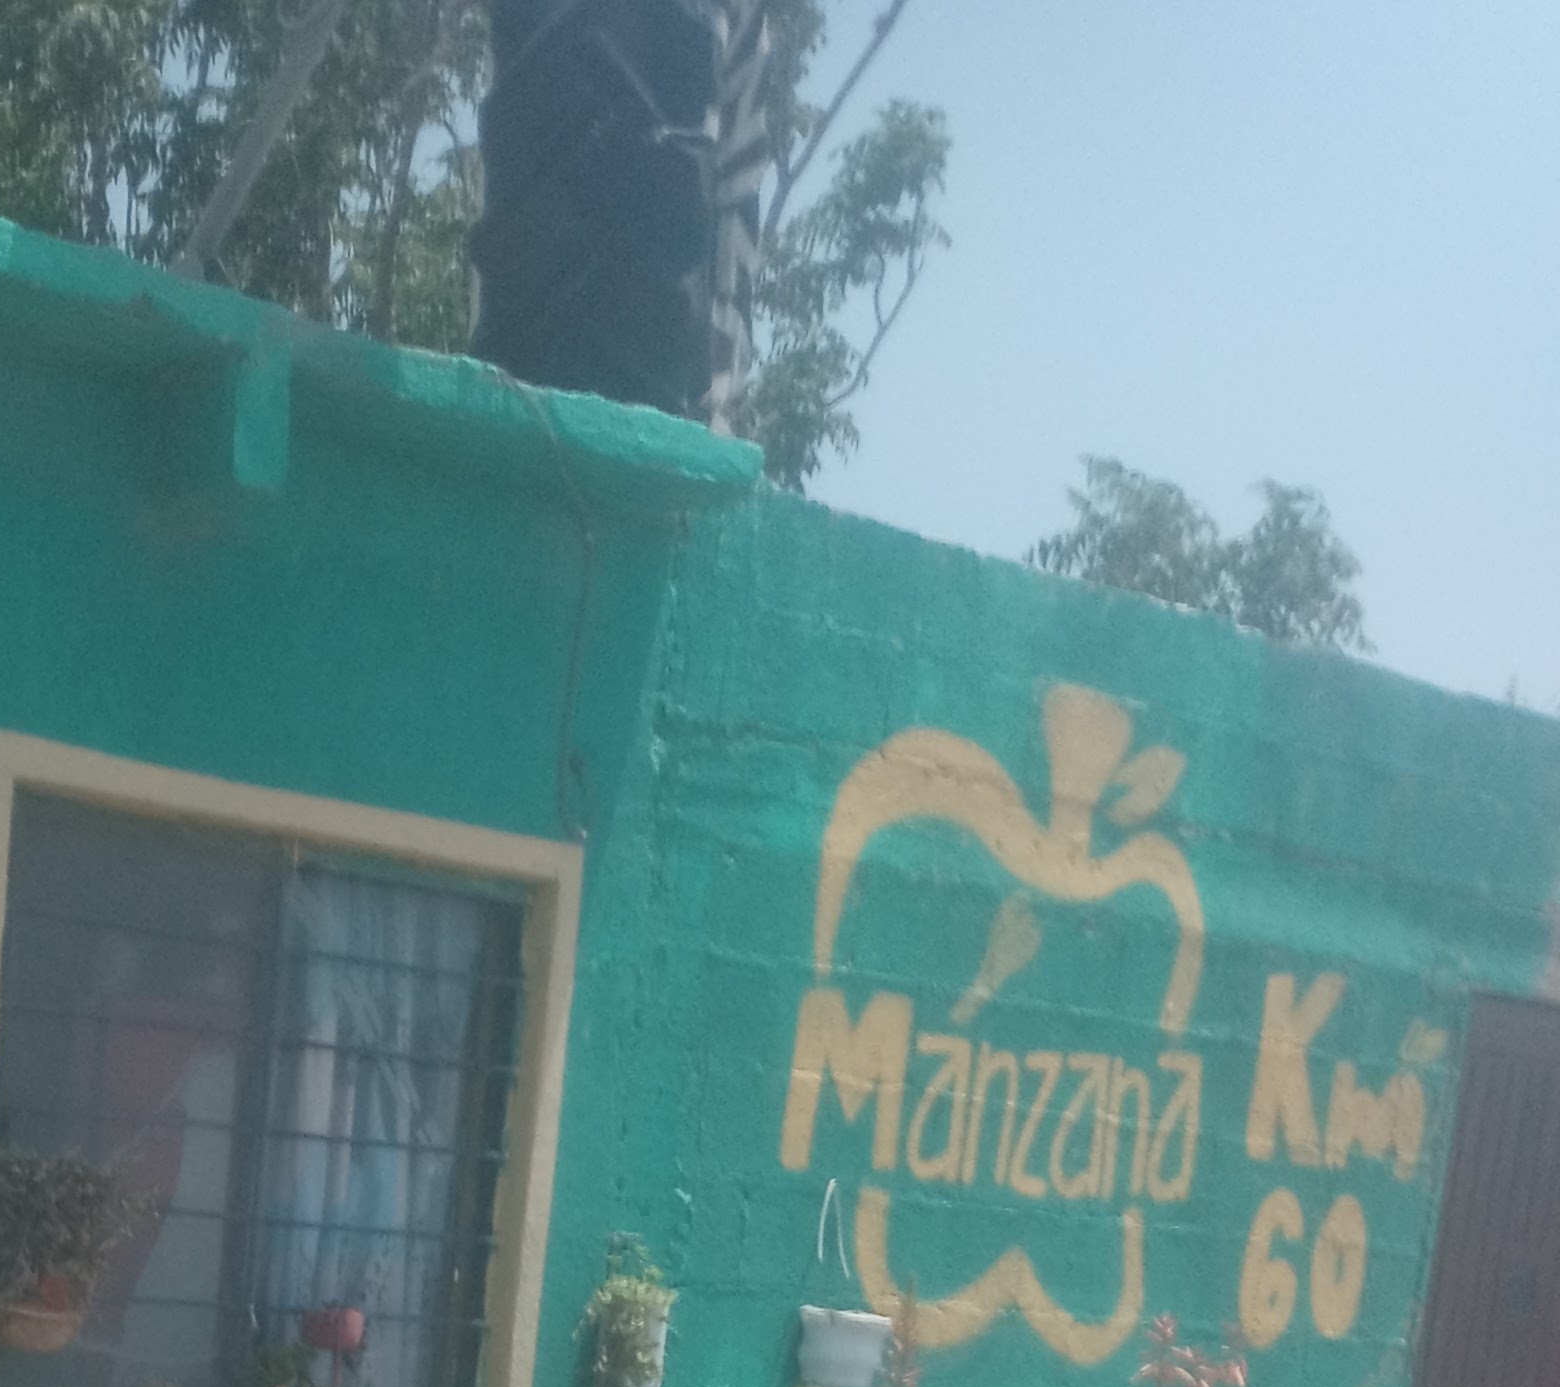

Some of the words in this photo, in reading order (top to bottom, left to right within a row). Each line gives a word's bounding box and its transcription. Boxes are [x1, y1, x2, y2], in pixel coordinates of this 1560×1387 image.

[780, 987, 1203, 1202] Manzana
[1246, 971, 1425, 1182] Km
[1239, 1187, 1368, 1350] 60
